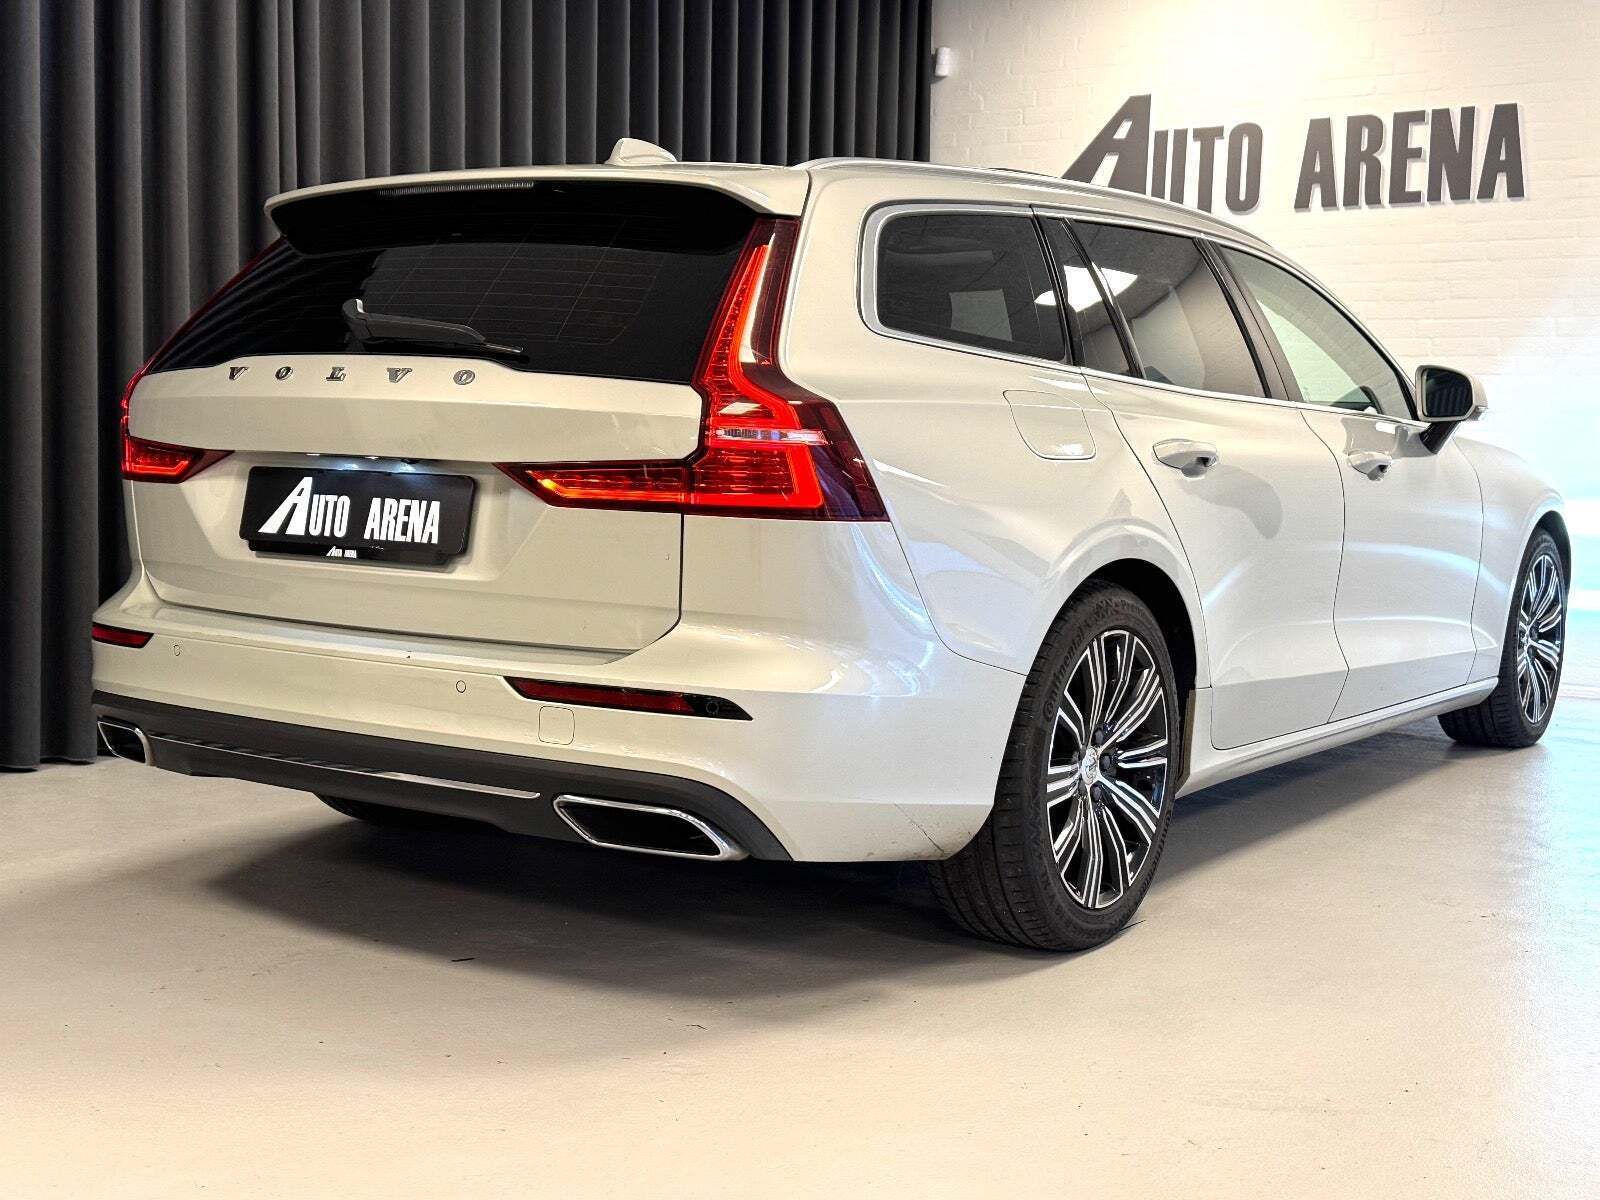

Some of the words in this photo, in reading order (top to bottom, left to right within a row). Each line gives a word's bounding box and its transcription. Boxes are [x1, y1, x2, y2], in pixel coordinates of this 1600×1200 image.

[1060, 94, 1263, 213] AUTO
[1294, 103, 1525, 212] ARENA
[228, 366, 476, 386] VOLVO
[258, 476, 350, 538] AUTO
[363, 497, 440, 544] ARENA
